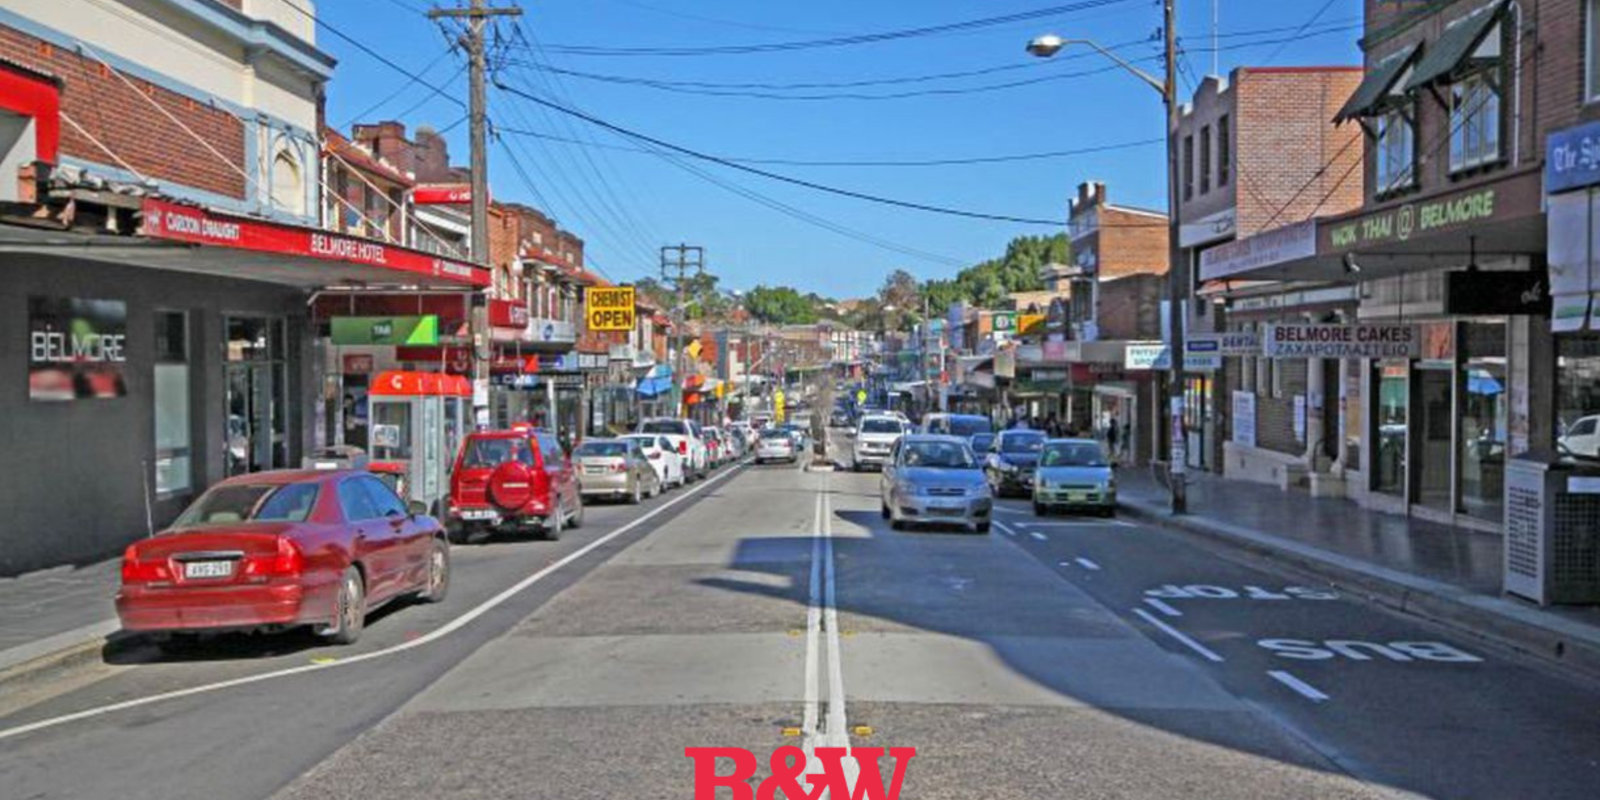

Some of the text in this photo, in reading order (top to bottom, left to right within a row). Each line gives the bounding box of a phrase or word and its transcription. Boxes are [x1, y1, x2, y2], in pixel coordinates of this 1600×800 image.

[1331, 225, 1357, 246] WOK
[1363, 214, 1392, 240] THAI
[1420, 190, 1494, 230] BELMORE
[202, 218, 240, 239] DRAUGHT
[311, 233, 386, 264] BELMORE HOTEL
[591, 290, 632, 308] CHEMIST
[592, 311, 632, 327] OPEN
[1222, 336, 1260, 348] DENTAL
[1274, 326, 1412, 342] BELMORE CAKES
[31, 331, 126, 361] BELMORE
[1144, 584, 1340, 600] STOP
[1257, 637, 1484, 663] BUS
